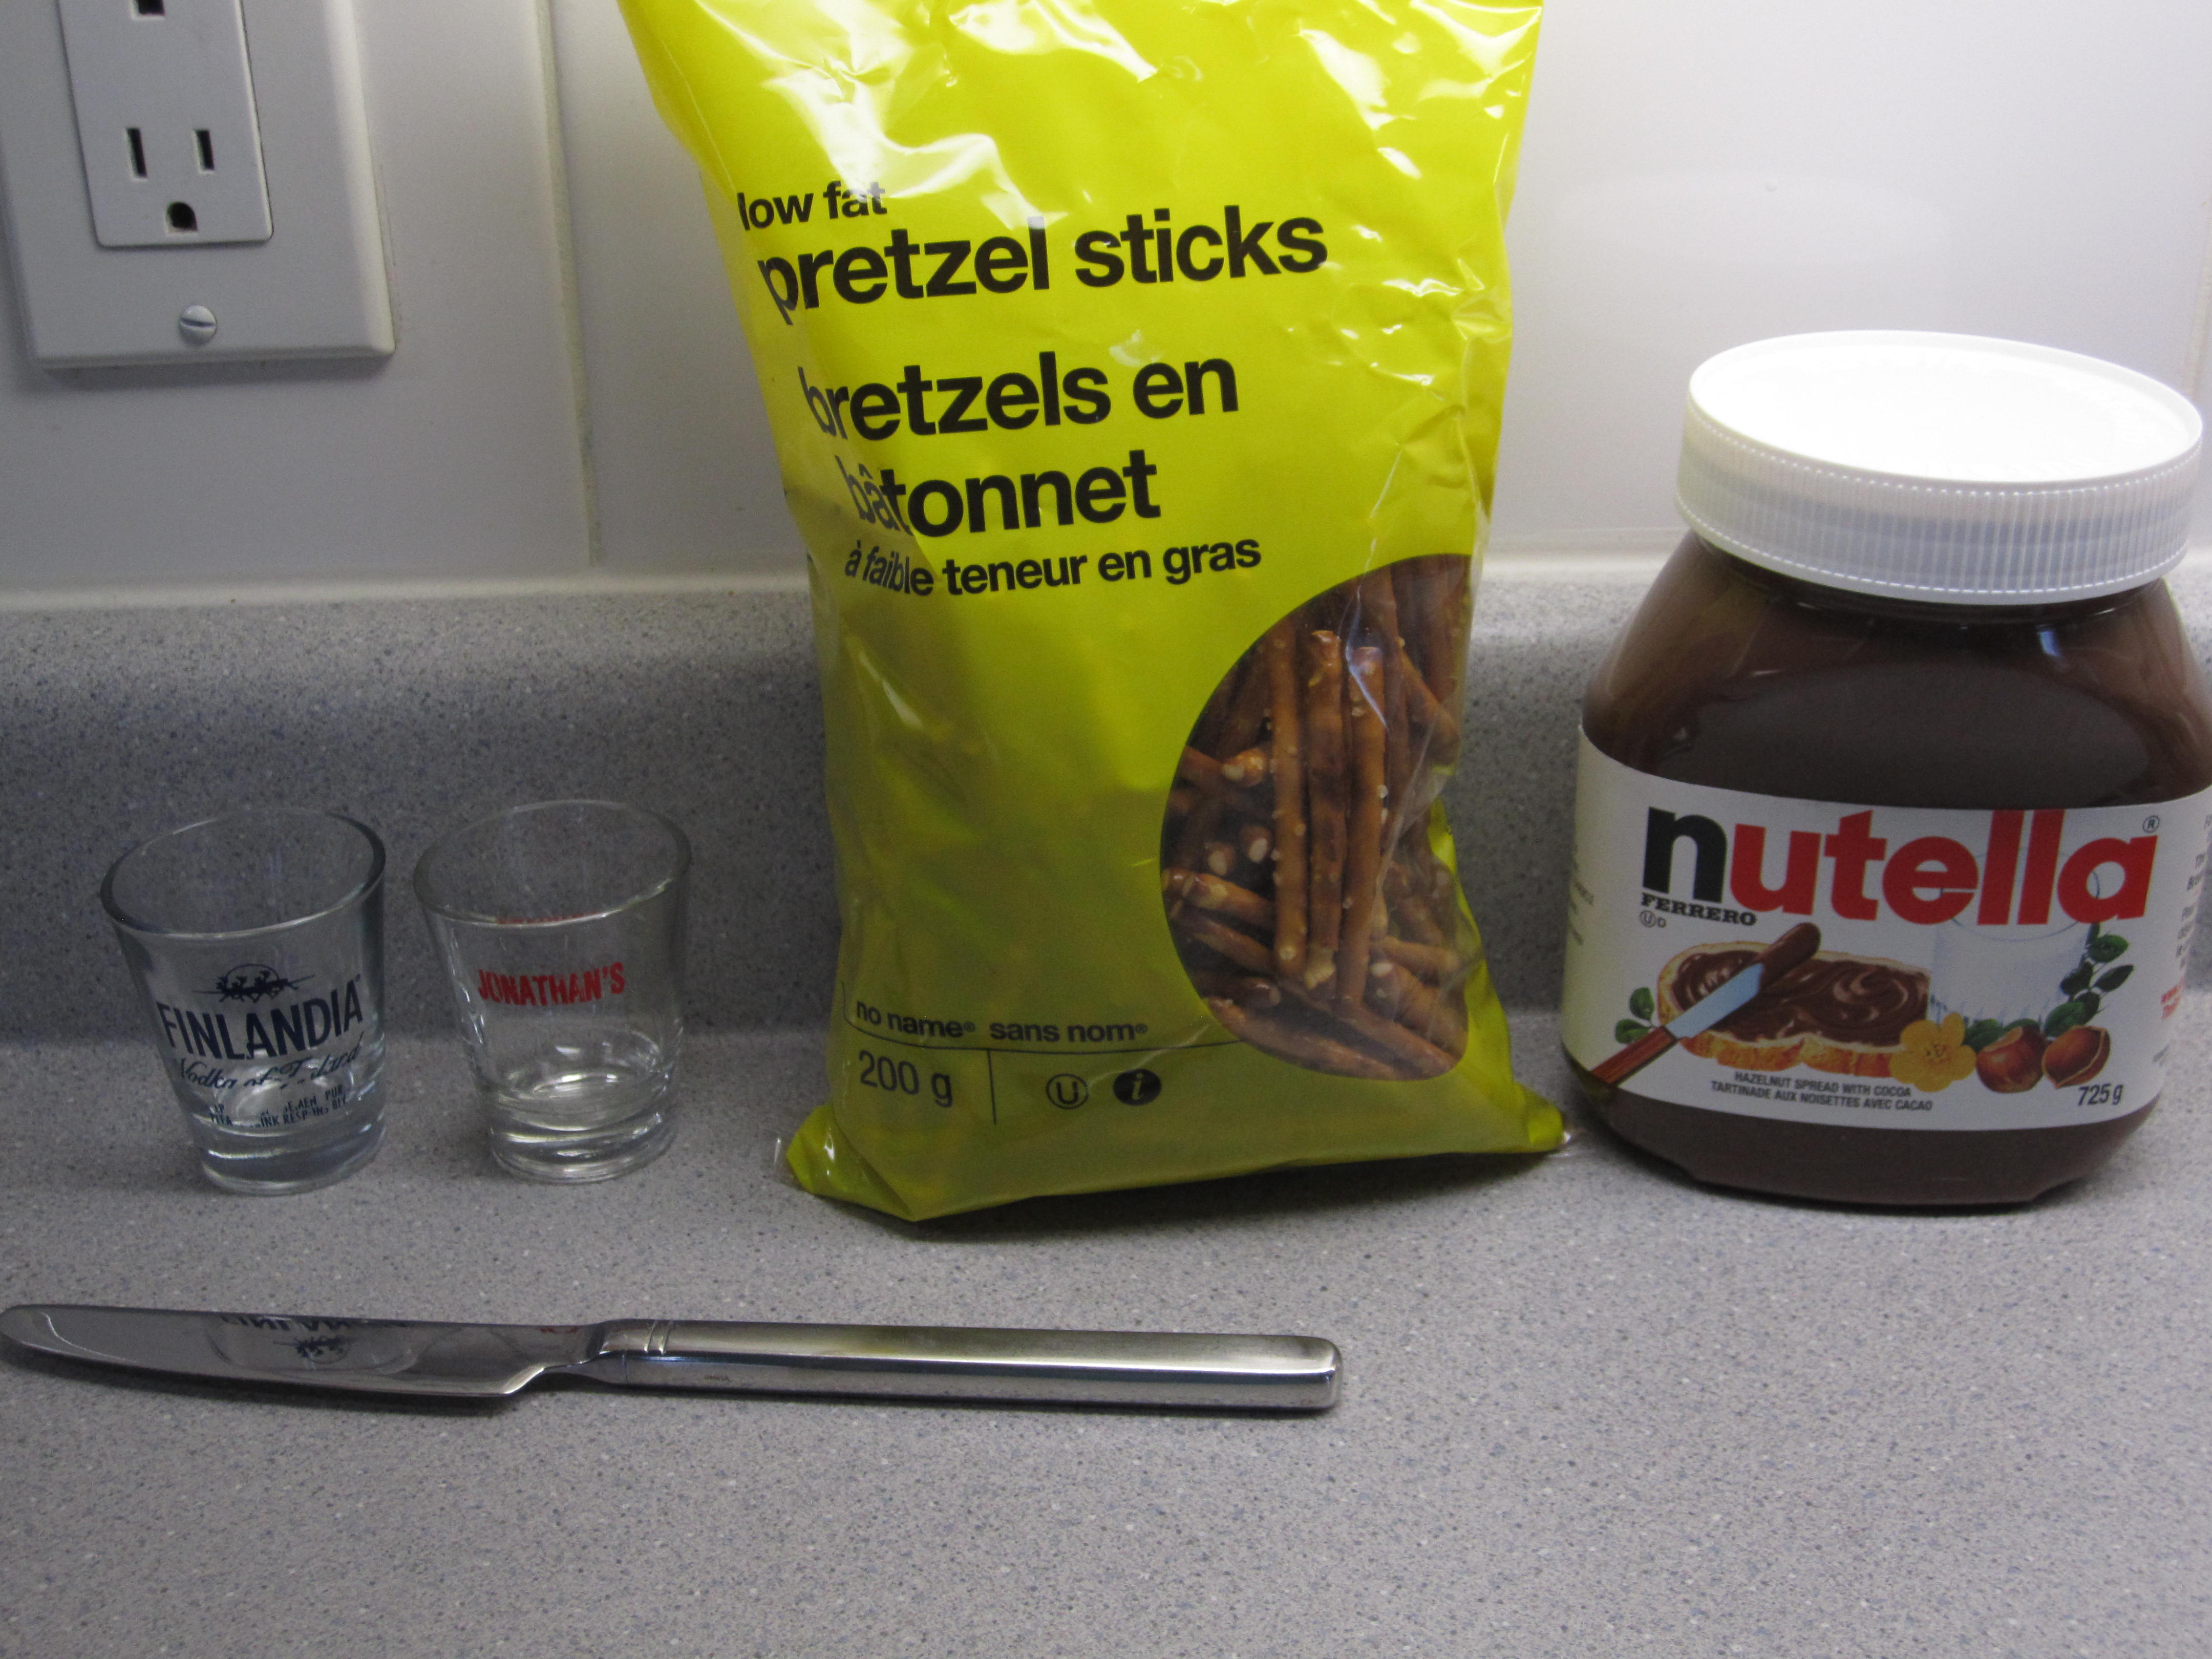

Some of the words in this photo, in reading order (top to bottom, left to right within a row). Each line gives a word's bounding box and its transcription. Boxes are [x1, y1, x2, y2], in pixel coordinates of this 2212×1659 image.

[737, 192, 814, 231] low
[823, 180, 887, 220] fat
[757, 216, 1050, 326] pretzel
[1074, 204, 1328, 288] sticks
[797, 351, 1112, 441] bretzels
[1133, 357, 1239, 419] en
[835, 449, 1161, 538] bâtonnet
[844, 540, 862, 577] à
[862, 545, 934, 595] faible
[942, 553, 1087, 595] teneur
[1098, 549, 1151, 583] en
[1163, 538, 1261, 585] gras
[1641, 891, 1757, 926] FERRERO
[478, 961, 626, 1006] JONATHAN'S
[156, 979, 364, 1060] FINLANDIA
[857, 1000, 881, 1025] no
[990, 1023, 1060, 1043] sans
[858, 1050, 920, 1095] 200
[931, 1072, 954, 1108] g
[1711, 1080, 1772, 1100] TARTINADE
[1774, 1090, 1797, 1102] AUX
[1799, 1091, 1861, 1109] NOISETTES
[1863, 1097, 1892, 1111] AVEC
[1895, 1099, 1933, 1112] CACAO
[1735, 1072, 1791, 1089] HAZELNUT
[1794, 1079, 1840, 1094] SPREAD
[1843, 1083, 1871, 1095] WITH
[1874, 1086, 1912, 1097] COCOA
